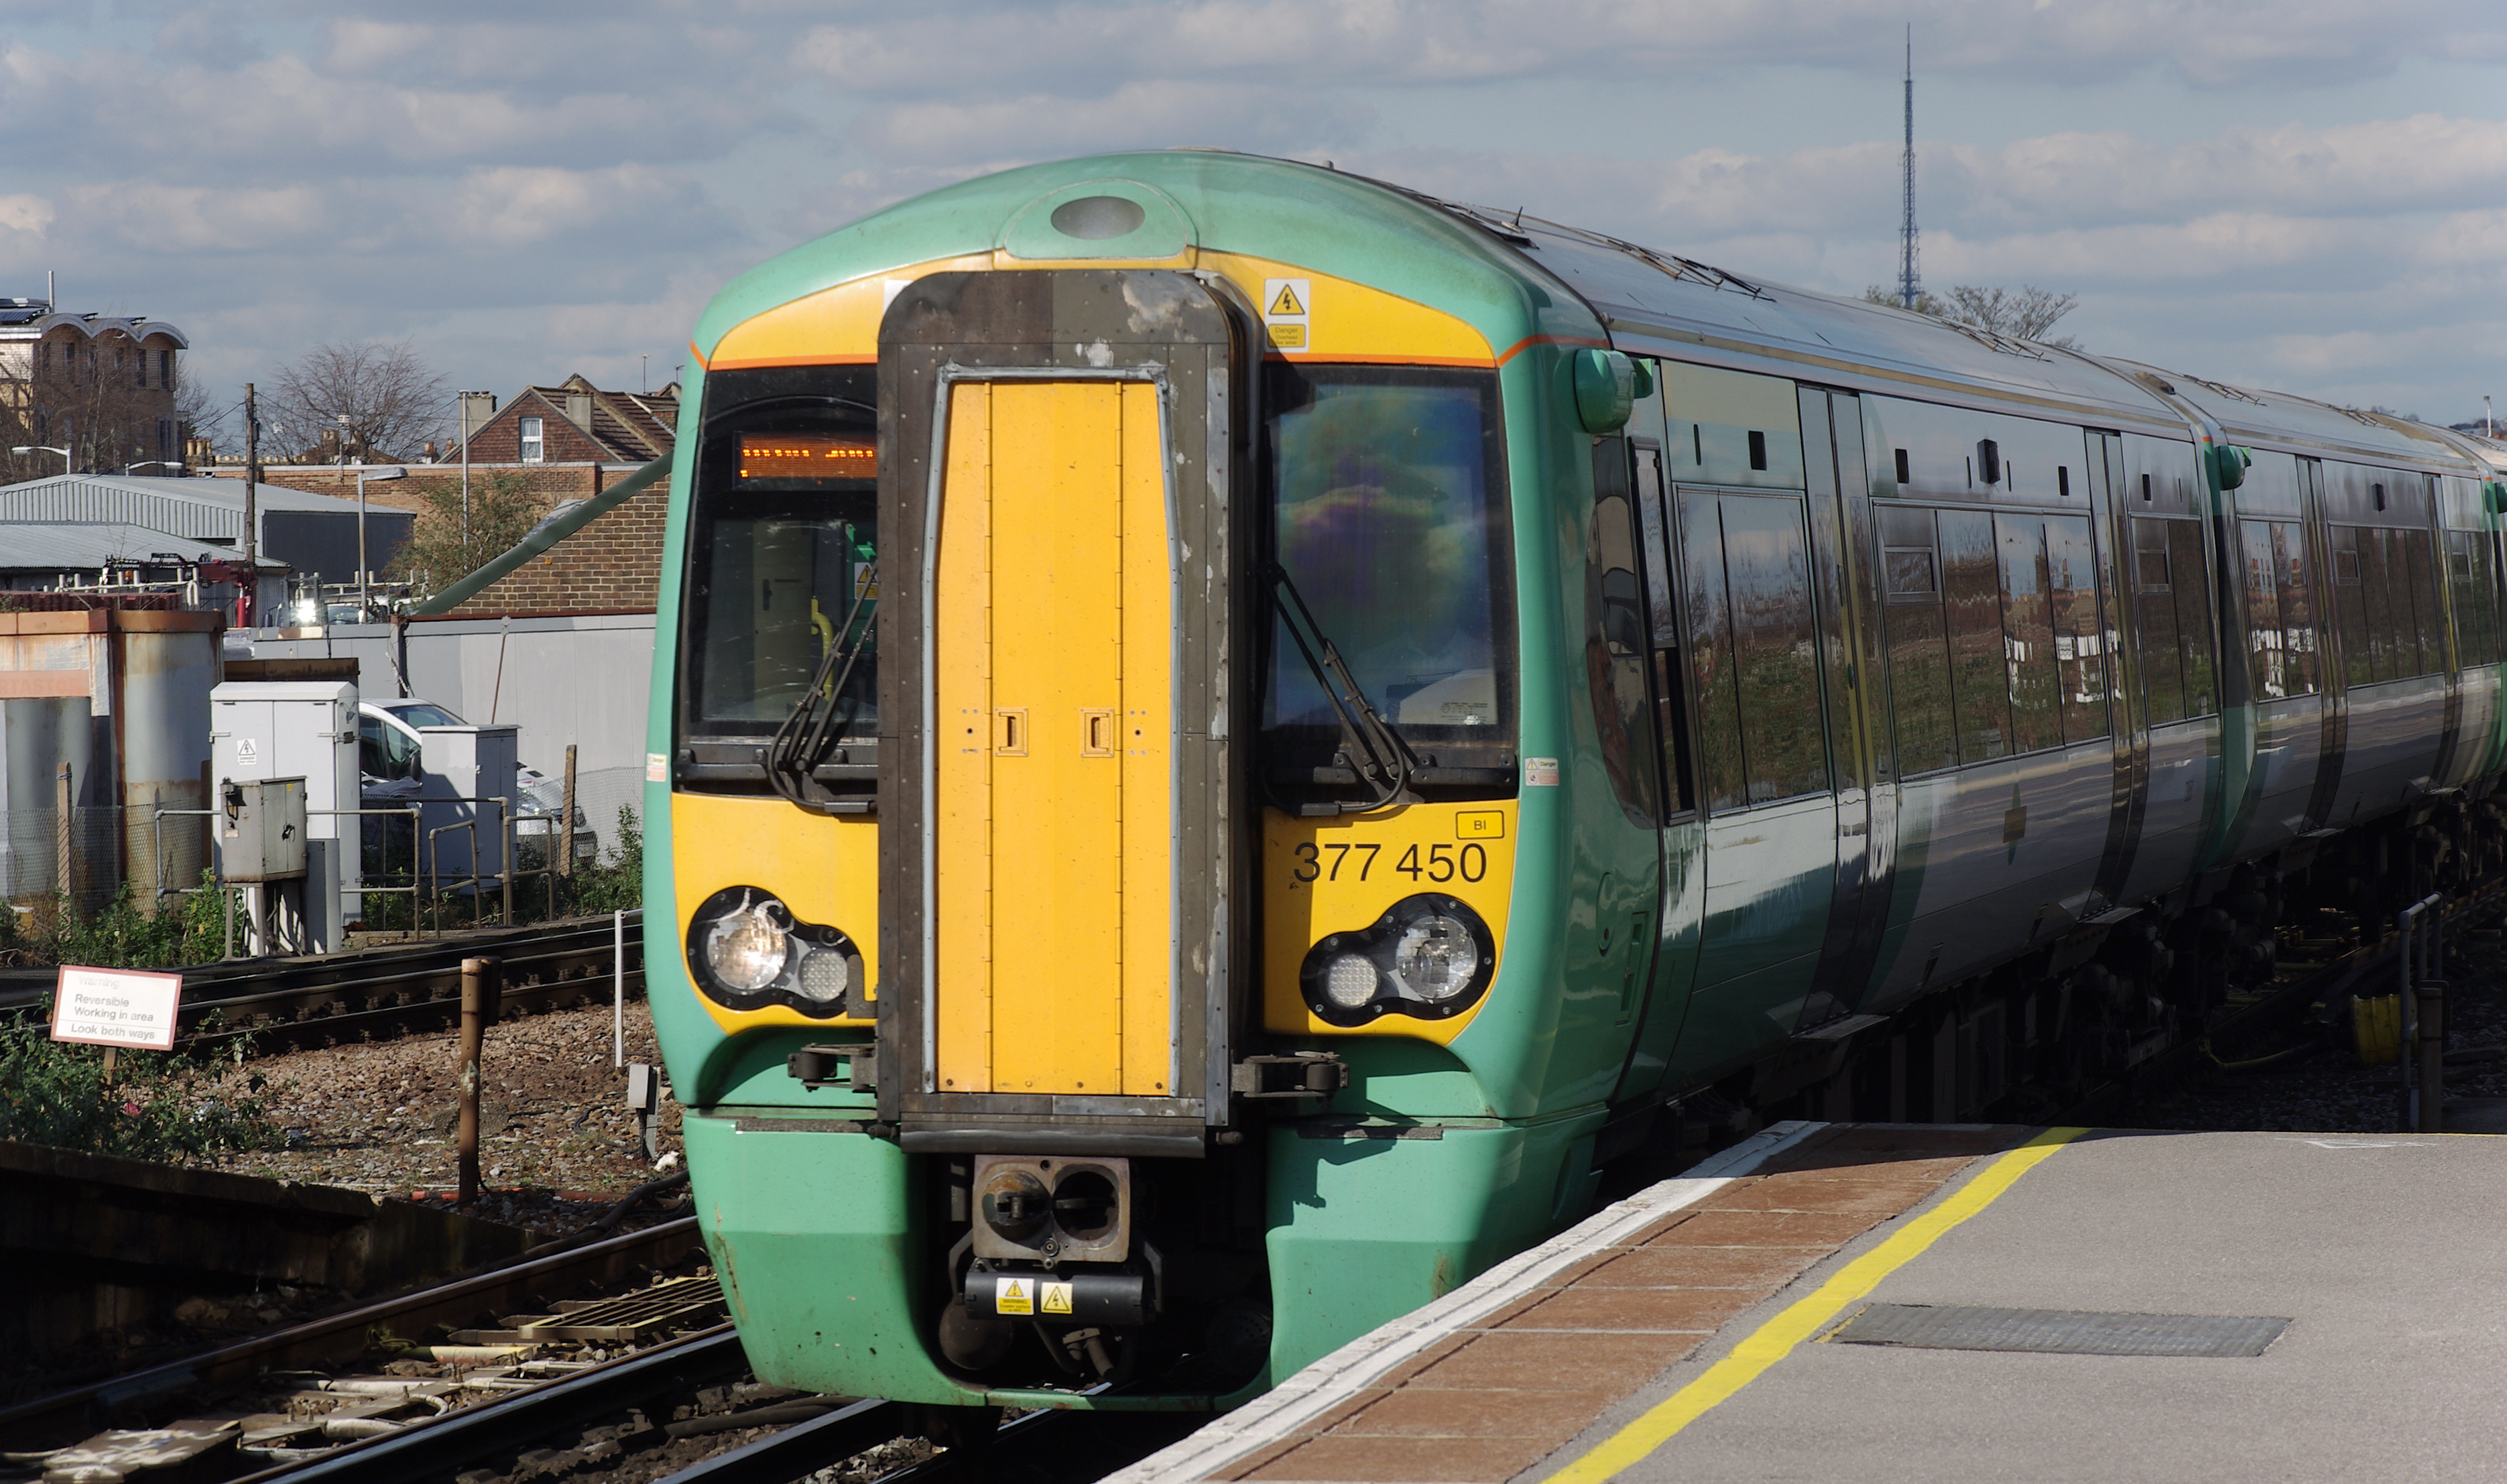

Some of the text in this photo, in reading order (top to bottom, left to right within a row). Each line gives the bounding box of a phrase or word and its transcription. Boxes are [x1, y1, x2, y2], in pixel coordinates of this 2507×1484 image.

[1275, 326, 1298, 334] Danger
[1294, 842, 1487, 883] 377 450
[78, 975, 120, 989] Warning
[75, 993, 129, 1007] Reversible
[74, 1006, 154, 1022] Working in area
[71, 1023, 155, 1041] Look both ways
